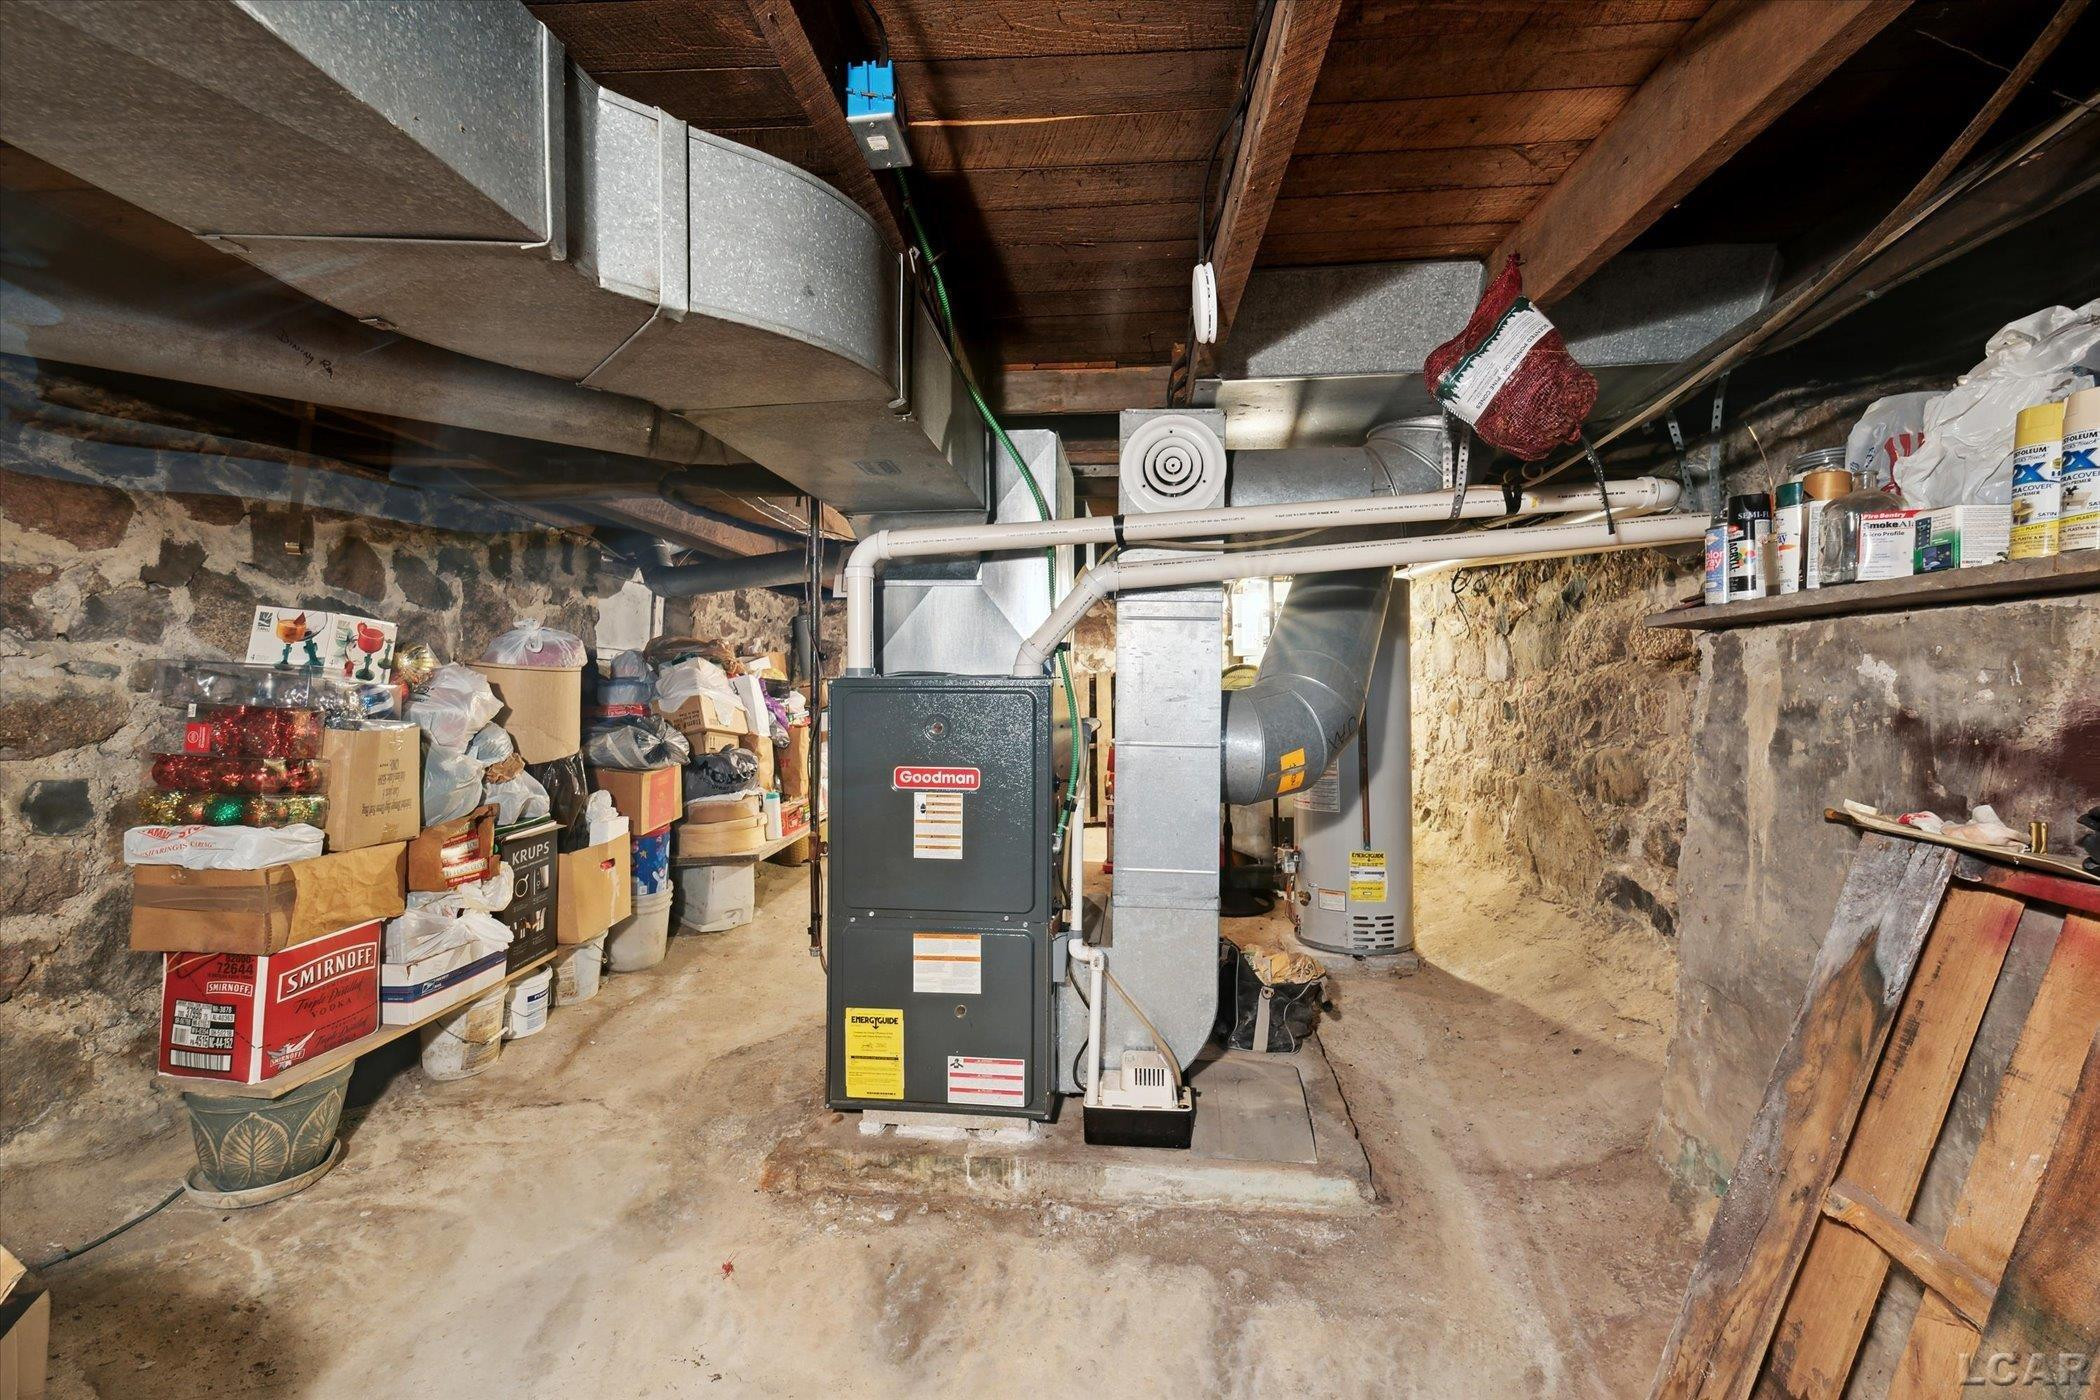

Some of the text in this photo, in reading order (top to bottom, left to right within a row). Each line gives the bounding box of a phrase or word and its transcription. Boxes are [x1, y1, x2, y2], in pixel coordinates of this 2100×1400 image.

[1476, 391, 1491, 410] CONES
[900, 770, 975, 784] Goodman
[512, 841, 550, 866] KRUPS
[218, 962, 254, 976] 72644
[286, 948, 372, 994] SMIRNOFF
[208, 982, 250, 994] SMIRNOFF
[851, 1016, 898, 1025] ENERGYGUIDE
